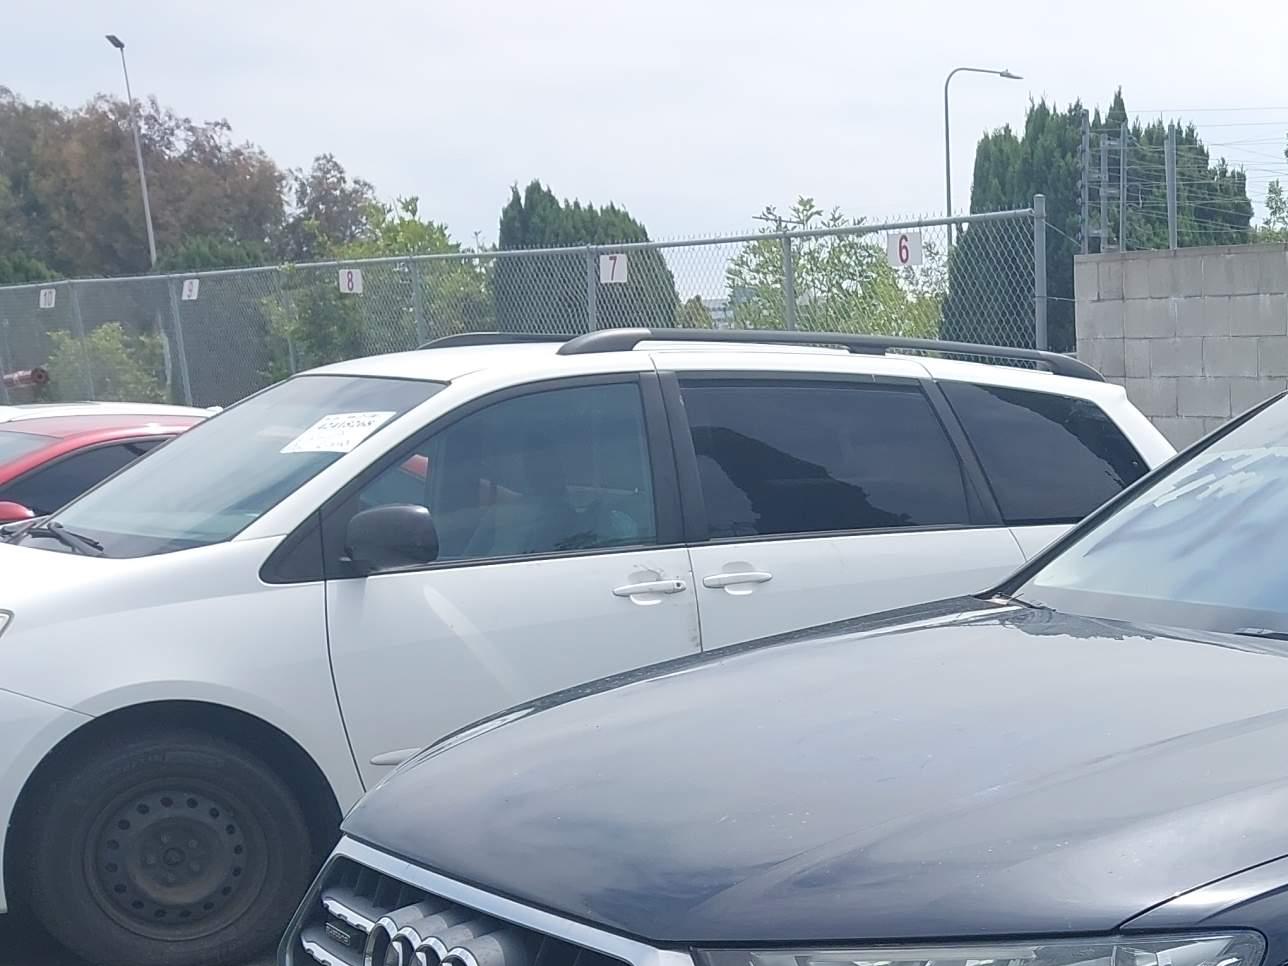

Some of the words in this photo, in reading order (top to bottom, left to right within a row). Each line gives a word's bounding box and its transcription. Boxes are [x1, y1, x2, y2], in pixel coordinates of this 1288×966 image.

[899, 234, 909, 264] 6
[346, 270, 354, 292] 8
[608, 255, 618, 281] 7
